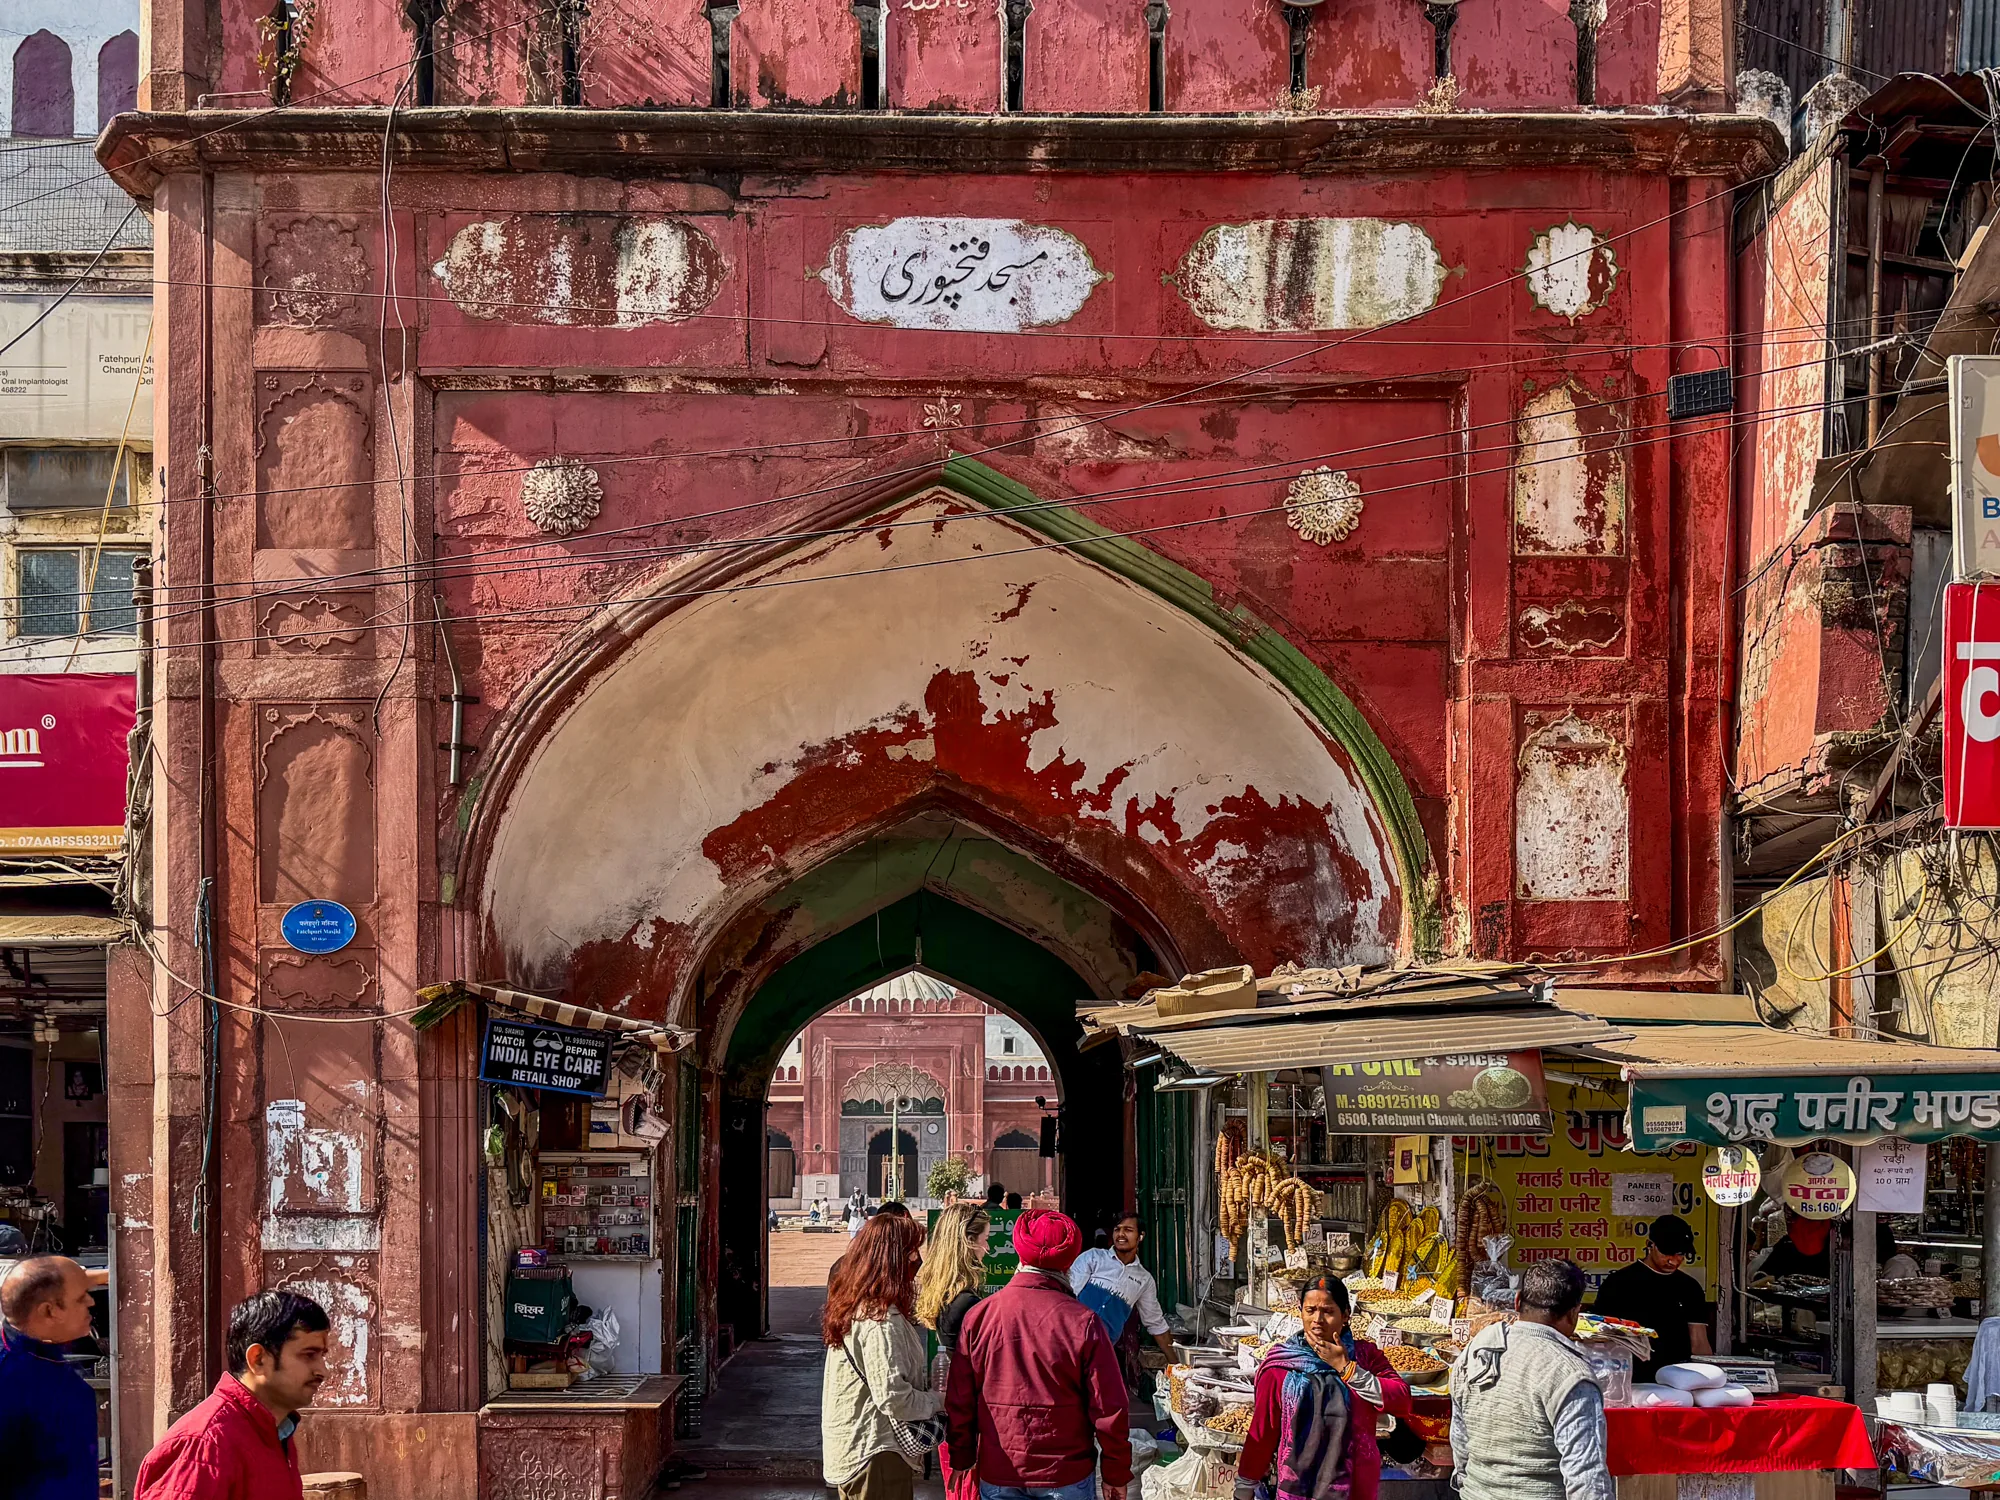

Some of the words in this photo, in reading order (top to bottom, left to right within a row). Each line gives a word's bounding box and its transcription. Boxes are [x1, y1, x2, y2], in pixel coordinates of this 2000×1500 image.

[974, 250, 1048, 305] مسجد
[98, 354, 141, 364] Fatehpuri
[102, 365, 140, 375] Chandni
[18, 378, 69, 387] Implantologist
[492, 1034, 526, 1048] WATCH
[565, 1045, 598, 1057] REPAIR
[489, 1044, 529, 1066] INDIA
[533, 1050, 560, 1070] EYE
[564, 1055, 602, 1076] CARE
[1445, 1054, 1509, 1067] SPICES
[511, 1069, 549, 1085] RETAIL
[551, 1074, 582, 1089] SHOP
[1357, 1093, 1441, 1110] 9891251149
[1793, 1076, 1904, 1132] पनीर
[1337, 1112, 1371, 1127] 6500,
[1371, 1112, 1426, 1127] Fatehpuri
[1427, 1112, 1468, 1127] Chowk,
[1515, 1167, 1563, 1190] मलाई
[1568, 1166, 1611, 1188] पनीर
[1627, 1182, 1661, 1190] PANEER
[1705, 1168, 1731, 1188] मलाई
[1515, 1192, 1554, 1213] जीरा
[1558, 1192, 1602, 1213] पनीर
[1622, 1194, 1636, 1202] RS
[1644, 1194, 1666, 1203] 360/-
[1515, 1217, 1563, 1240] मलाई
[1568, 1217, 1609, 1241] रबड़ी
[1576, 1247, 1600, 1263] का
[1605, 1241, 1636, 1263] पेठा
[514, 1302, 545, 1315] शिखर
